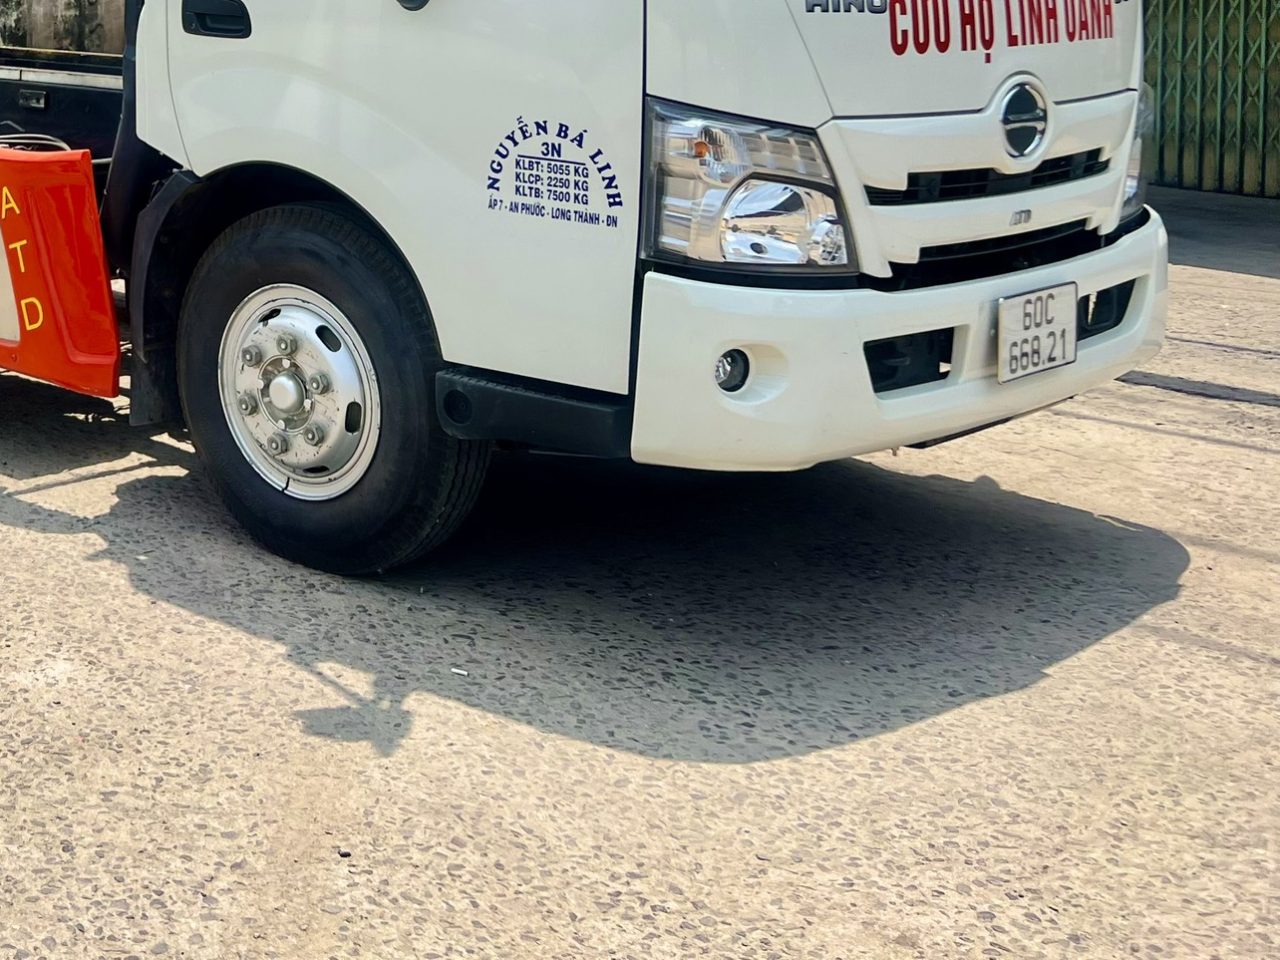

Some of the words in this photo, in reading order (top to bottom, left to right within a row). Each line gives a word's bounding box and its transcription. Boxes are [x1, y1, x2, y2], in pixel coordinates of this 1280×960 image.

[487, 115, 548, 191] NGUYỄN
[556, 122, 588, 149] BÁ
[589, 148, 623, 208] LINH
[540, 142, 562, 158] 3N
[515, 159, 544, 173] KLBT:
[546, 163, 571, 177] 5055
[573, 166, 589, 179] KG
[515, 172, 544, 186] KLCP:
[546, 176, 571, 189] 2250
[573, 179, 589, 192] KG
[515, 185, 544, 199] KLTB:
[546, 189, 571, 203] 7500
[573, 193, 589, 206] KG
[509, 201, 519, 214] AN
[551, 207, 571, 221] LONG
[573, 207, 600, 226] THÀNH
[606, 214, 618, 228] ĐN
[1022, 292, 1056, 331] 60C
[1009, 327, 1067, 375] 668.21
